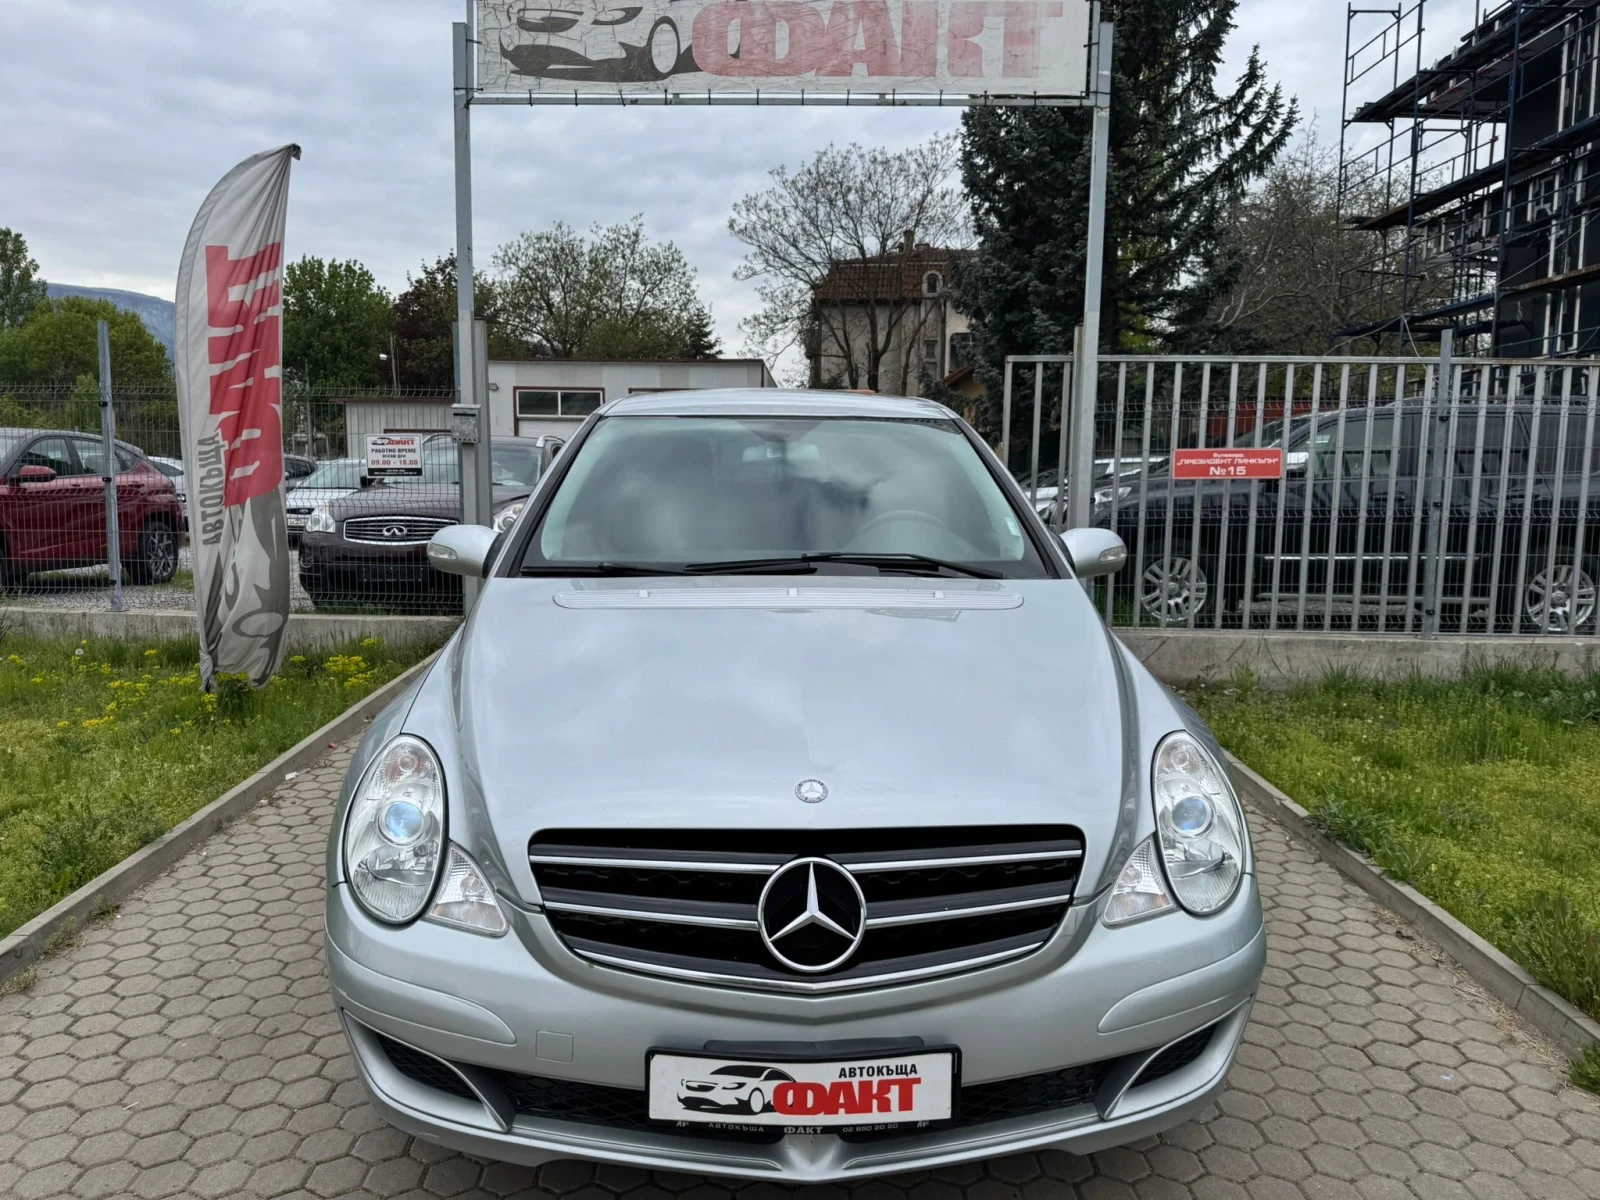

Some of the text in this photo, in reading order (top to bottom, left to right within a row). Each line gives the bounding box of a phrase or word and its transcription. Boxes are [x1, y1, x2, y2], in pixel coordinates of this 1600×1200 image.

[691, 0, 1063, 77] ФАКТ
[205, 242, 282, 507] ФАКТ
[198, 431, 224, 546] АВТОКЪЩА
[772, 1077, 921, 1116] ФАКТ
[838, 1063, 918, 1079] АВТОКЪЩА
[783, 1126, 824, 1135] ФАКТ
